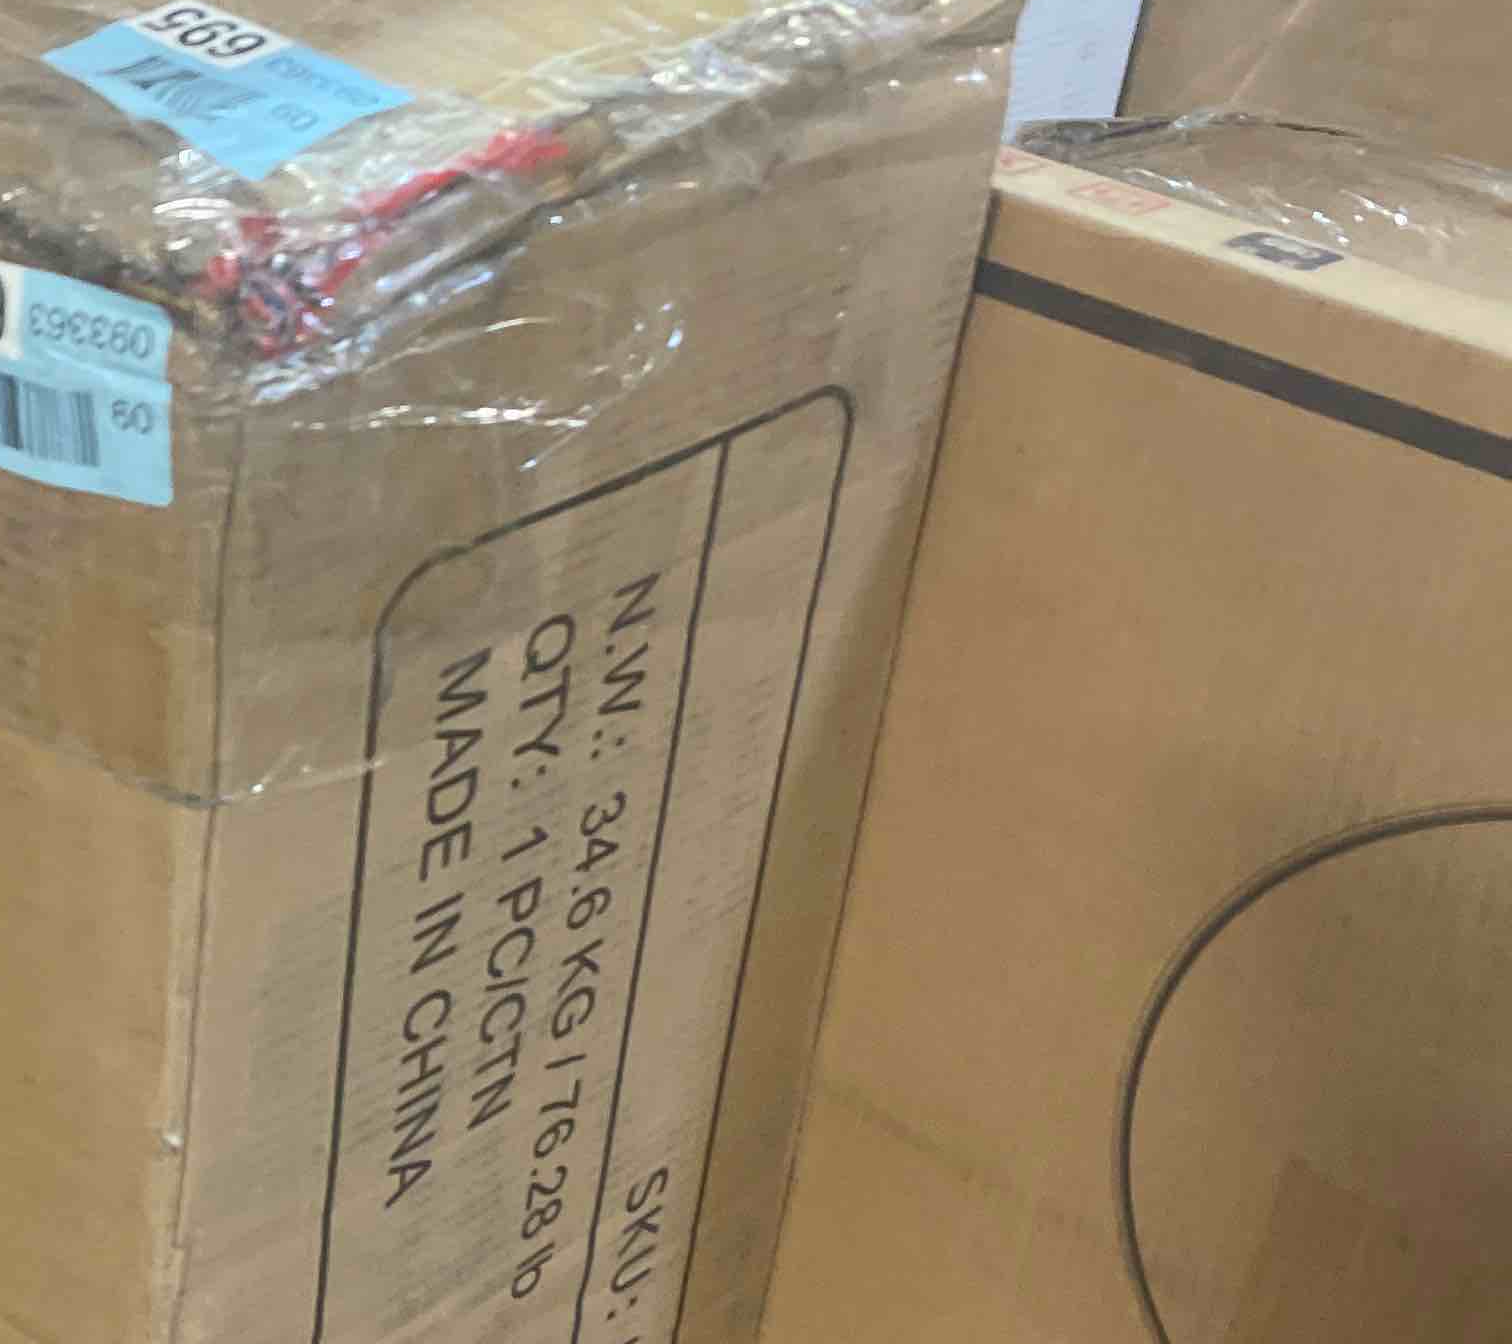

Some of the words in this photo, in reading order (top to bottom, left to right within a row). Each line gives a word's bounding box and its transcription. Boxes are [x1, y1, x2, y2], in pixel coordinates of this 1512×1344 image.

[147, 6, 267, 59] 695
[511, 613, 576, 789] QTY:
[589, 572, 661, 760] N.W.:
[419, 647, 491, 882] MADE
[501, 826, 549, 862] 1
[567, 791, 626, 930] 34.6
[410, 892, 464, 975] IN
[467, 877, 542, 1130] PC/CTN
[551, 939, 605, 1040] KG
[384, 989, 452, 1209] CHINA
[521, 1079, 582, 1240] 76.28
[511, 1242, 555, 1299] lb
[606, 1166, 669, 1322] SKU:
